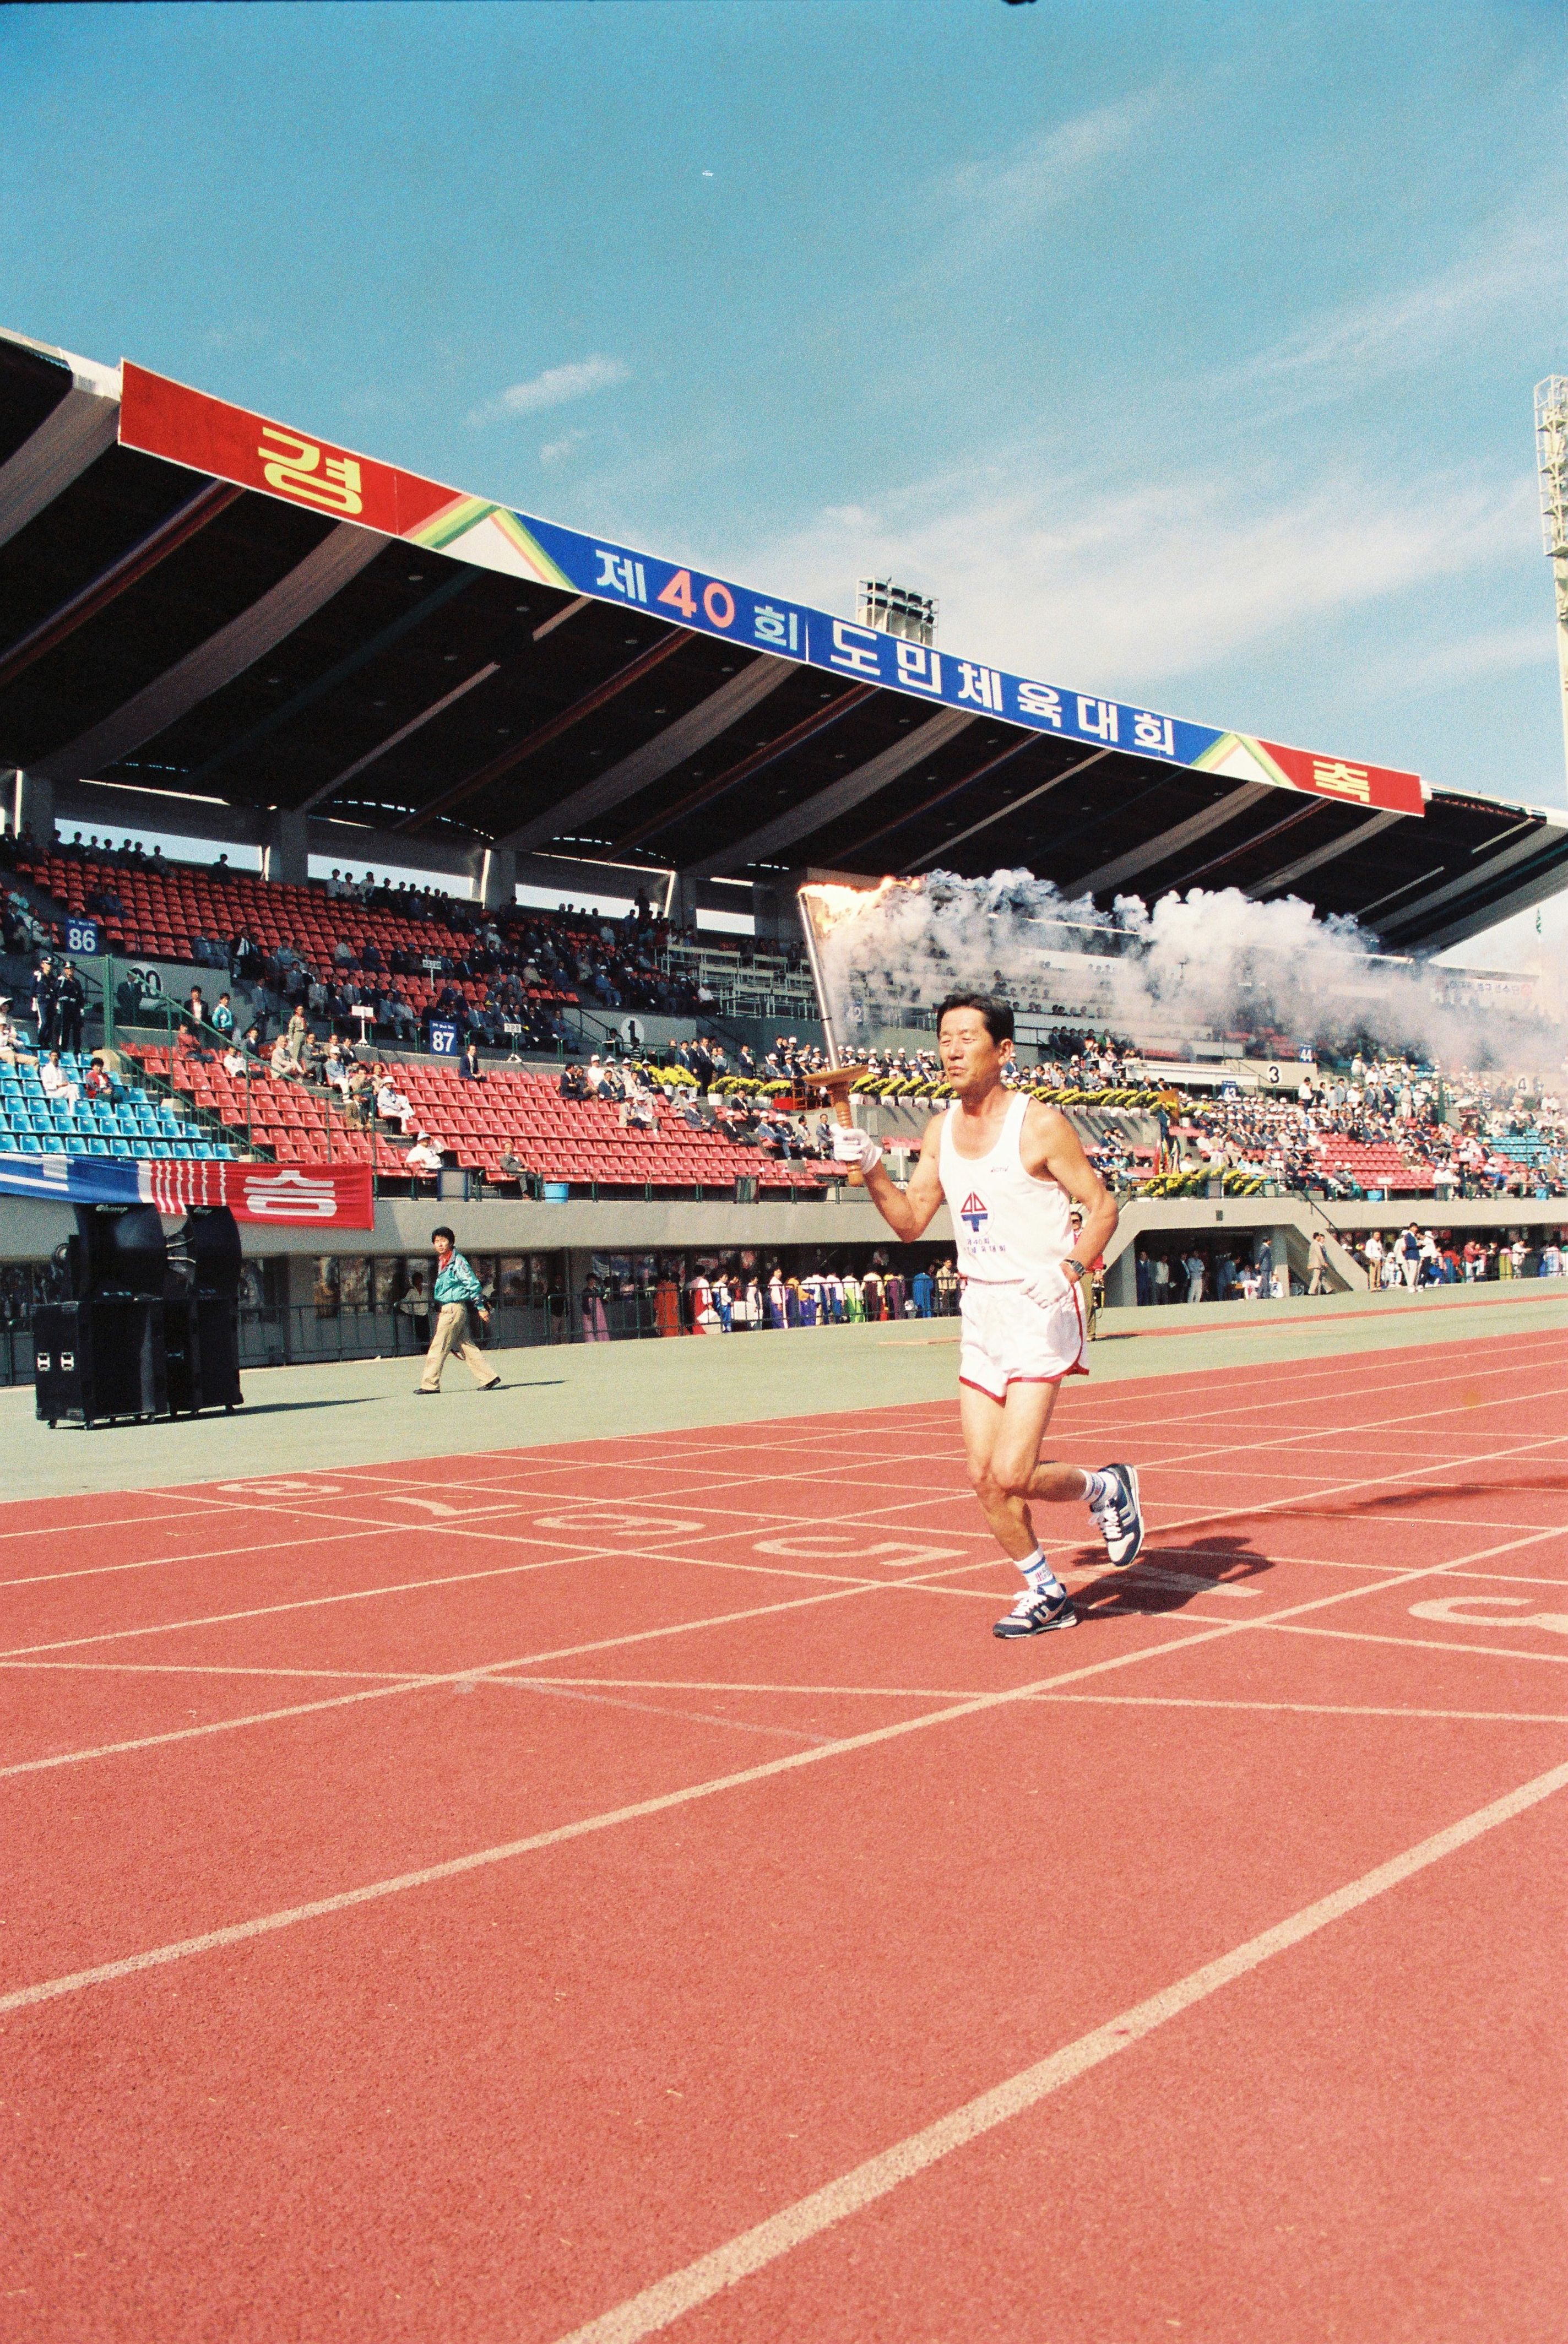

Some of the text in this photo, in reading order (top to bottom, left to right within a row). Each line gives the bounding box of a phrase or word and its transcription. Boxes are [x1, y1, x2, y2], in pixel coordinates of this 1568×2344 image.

[258, 426, 362, 514] 경
[831, 619, 1174, 756] 도민체육대회
[1313, 759, 1370, 803] 축
[69, 928, 96, 952] 86
[432, 1031, 454, 1053] 87
[1300, 1049, 1313, 1062] 44
[1269, 1066, 1279, 1084] 3
[242, 1170, 337, 1217] 승
[217, 1480, 343, 1497] 8
[380, 1496, 523, 1516] 7
[532, 1513, 707, 1537] 6
[752, 1535, 969, 1567] 5
